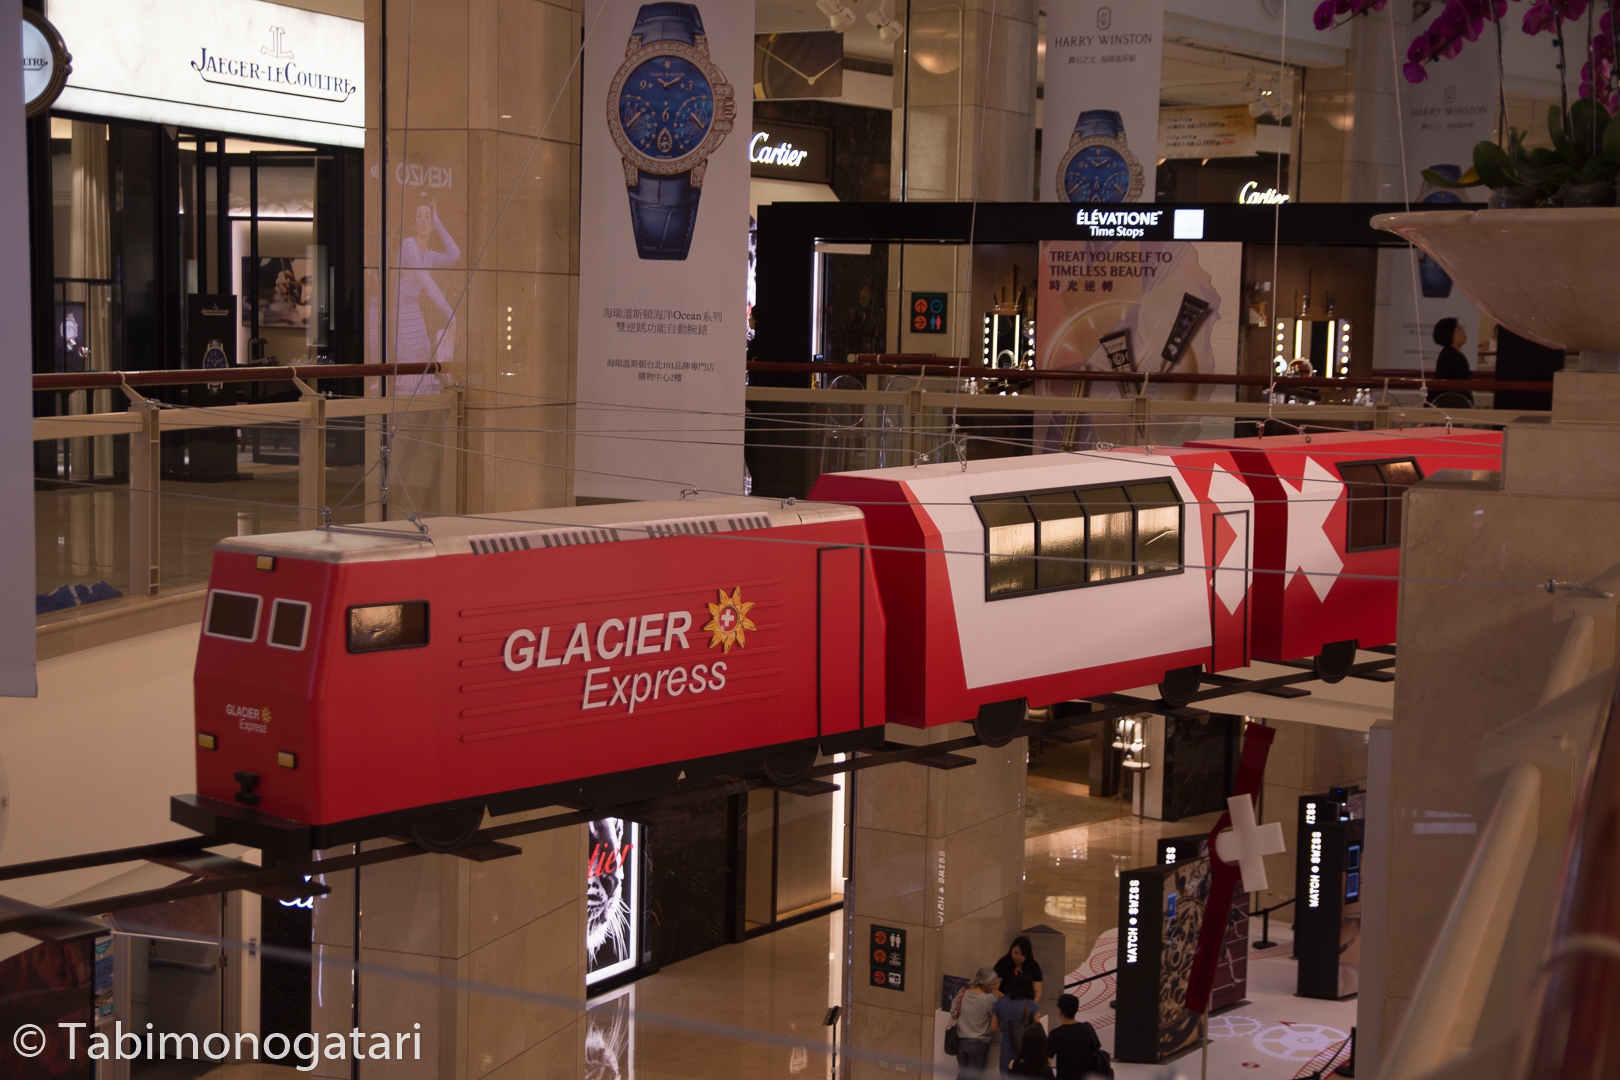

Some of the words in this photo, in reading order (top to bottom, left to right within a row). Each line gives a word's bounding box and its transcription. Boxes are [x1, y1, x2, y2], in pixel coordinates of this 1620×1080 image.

[1055, 35, 1094, 48] HARRY
[1098, 33, 1153, 46] WINSTON
[749, 131, 808, 167] Cartier
[1238, 180, 1290, 204] Cartier
[1089, 226, 1115, 237] Time
[1116, 226, 1144, 239] Stops
[1049, 250, 1086, 262] TREAT
[1089, 251, 1153, 263] YOURSELF
[1155, 251, 1173, 263] TO
[1049, 265, 1107, 277] TIMELESS
[1110, 265, 1158, 278] BEAUTY
[503, 611, 692, 672] GLACIER
[582, 661, 728, 714] Express
[226, 704, 260, 719] GLACIER
[240, 718, 267, 733] Express
[588, 843, 634, 879] tier
[1310, 831, 1322, 864] SWISS
[1128, 879, 1140, 915] SWISS
[1309, 875, 1320, 908] WATCH
[1127, 927, 1139, 963] WATCH
